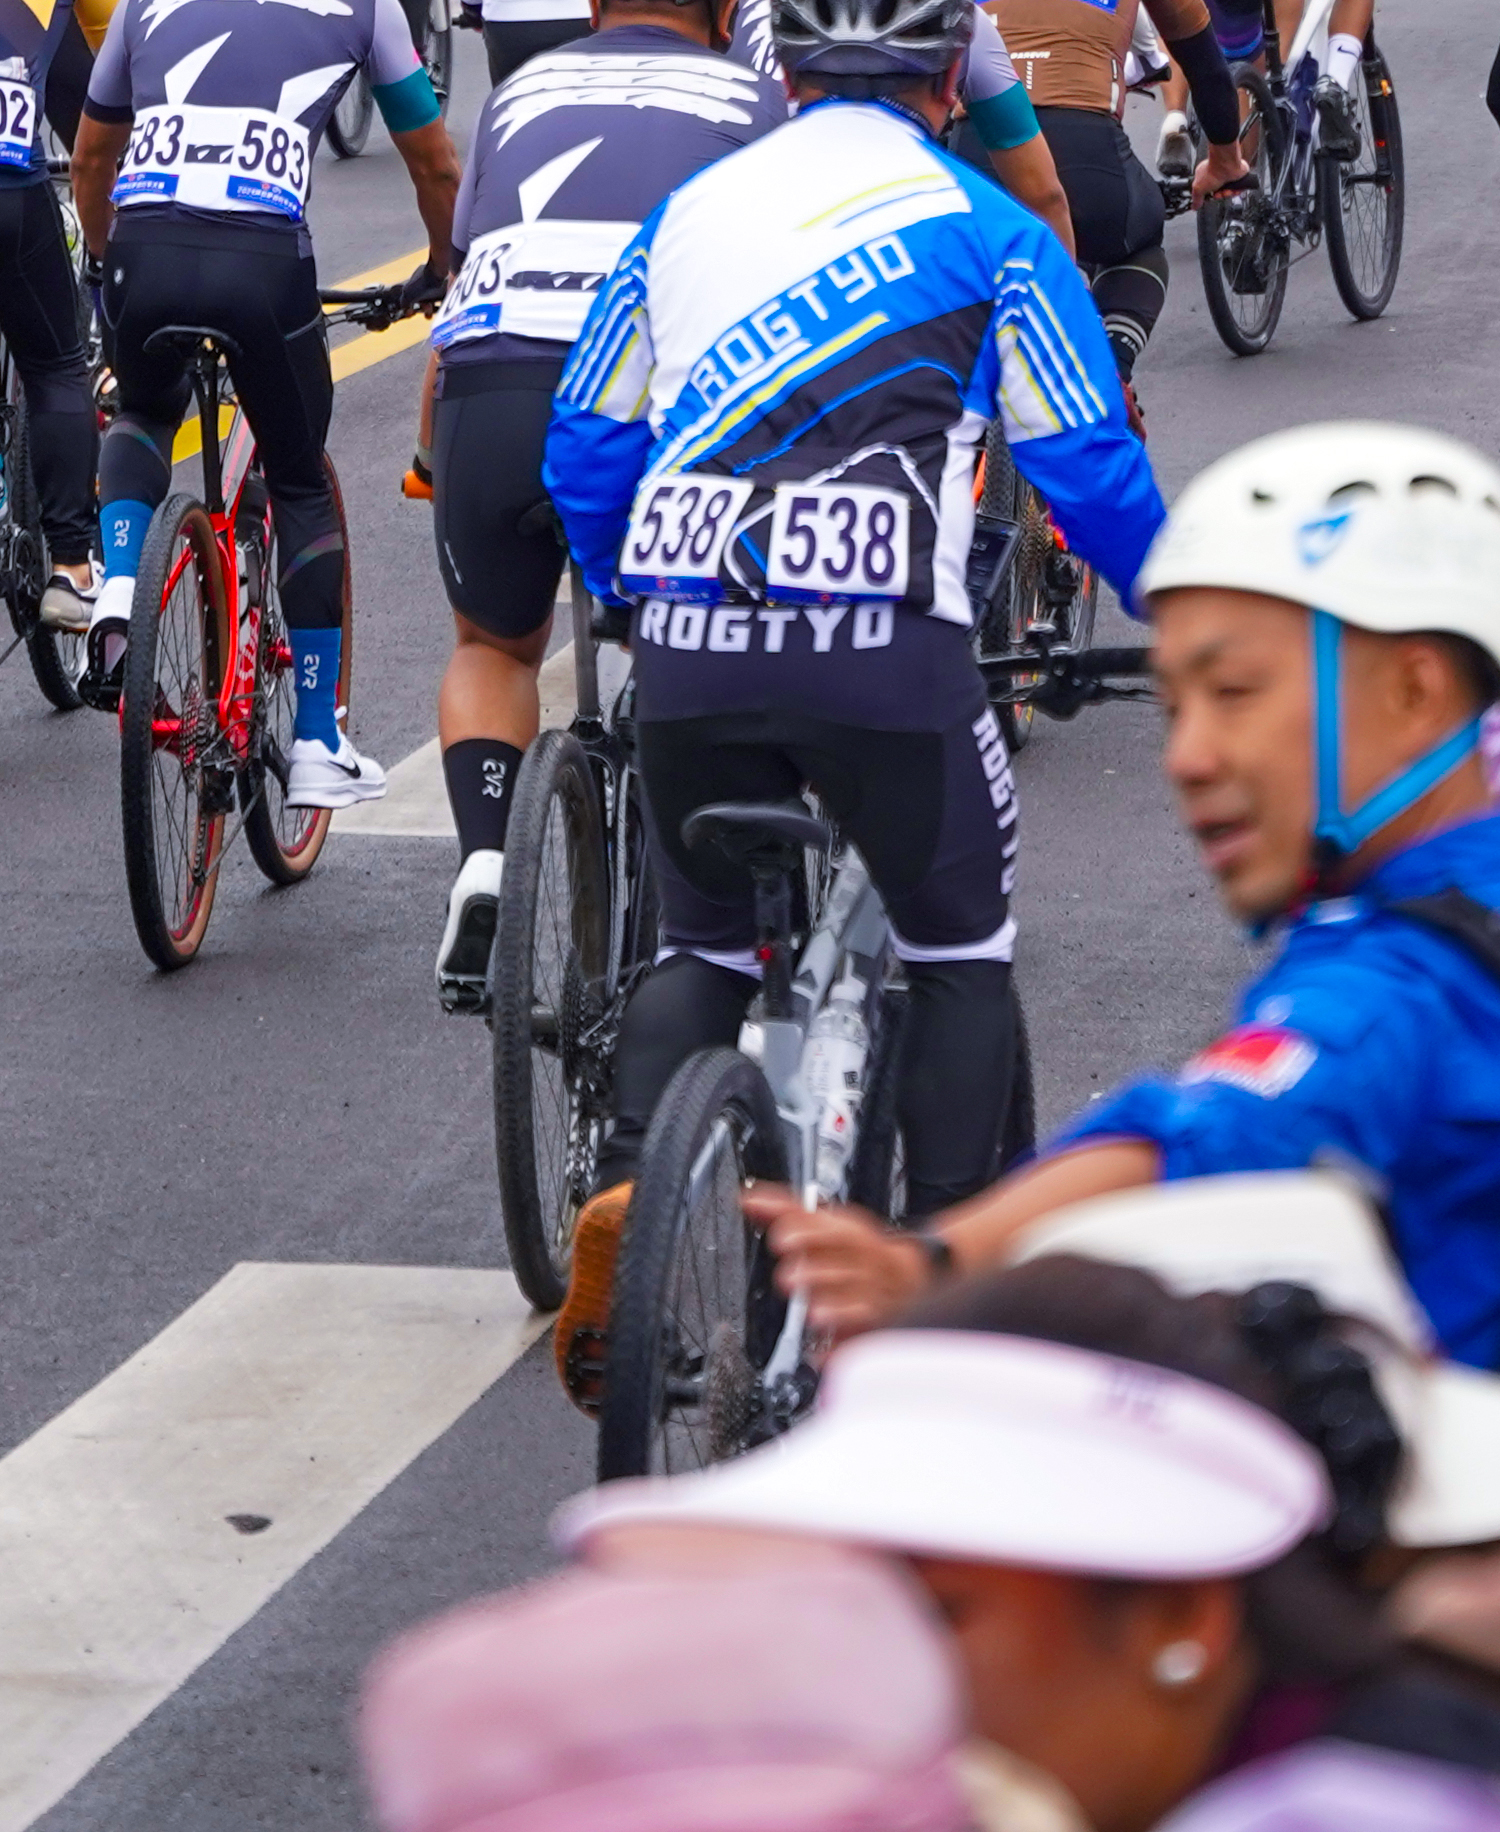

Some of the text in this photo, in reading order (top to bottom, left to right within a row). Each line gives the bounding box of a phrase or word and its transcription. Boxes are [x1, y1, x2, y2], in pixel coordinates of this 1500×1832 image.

[237, 120, 306, 191] 583
[689, 234, 918, 408] ROGTYO
[634, 485, 896, 582] 538 538
[640, 604, 895, 653] ROGTYO
